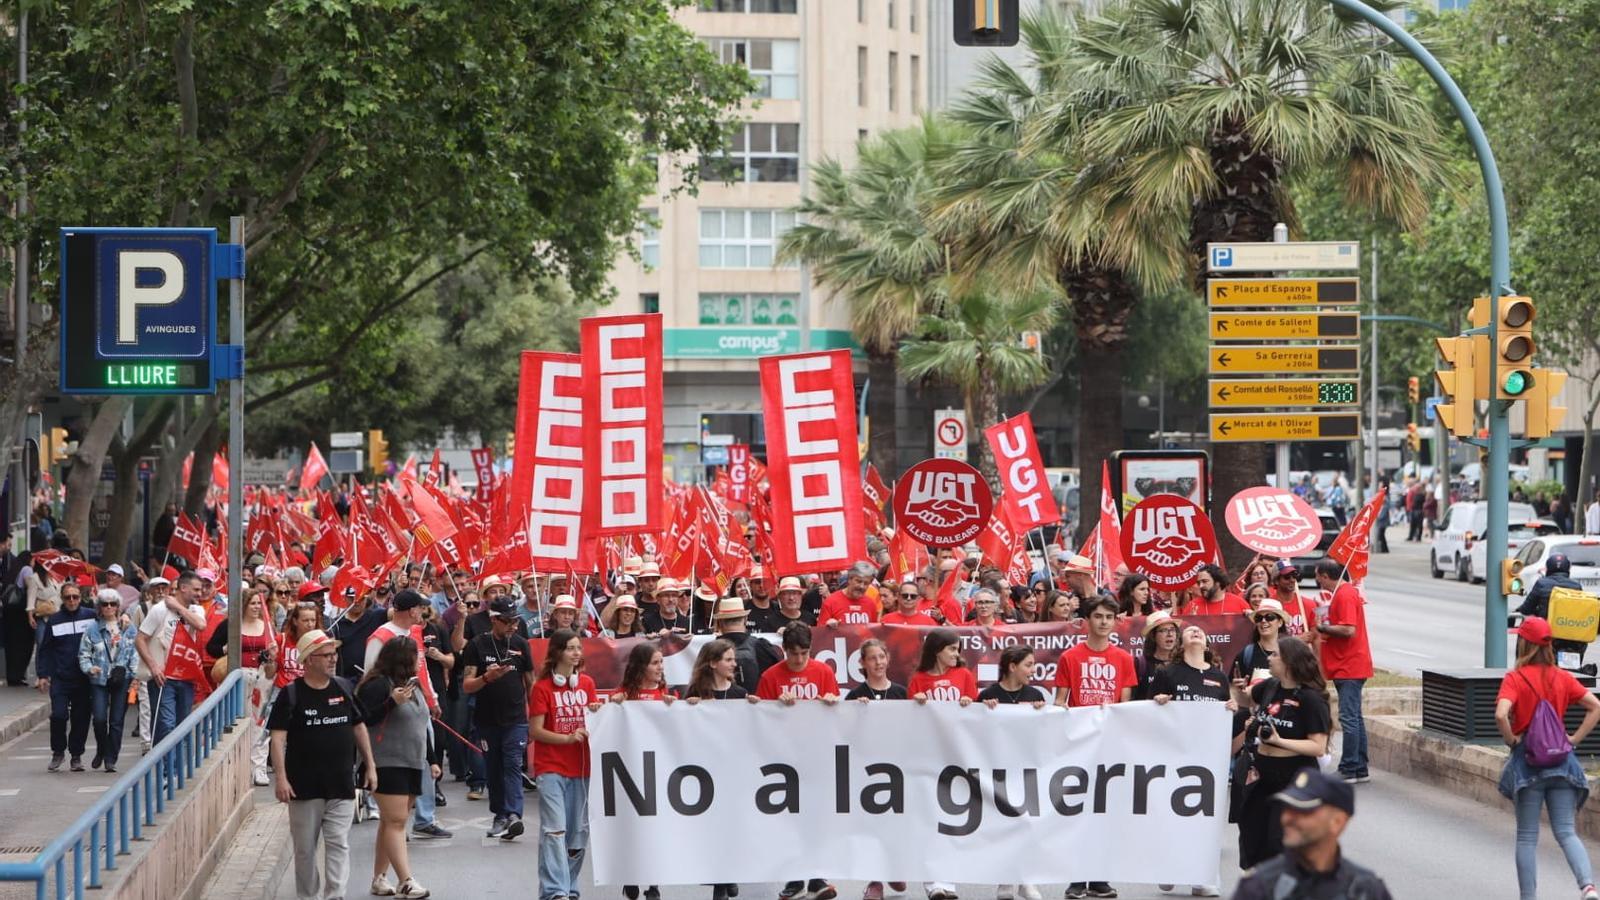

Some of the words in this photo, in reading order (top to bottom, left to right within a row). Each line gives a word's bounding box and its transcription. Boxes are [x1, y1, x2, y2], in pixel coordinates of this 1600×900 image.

[119, 252, 184, 342] P
[1233, 285, 1260, 294] Plaça
[1263, 285, 1312, 294] d'Espanya
[145, 325, 197, 334] AVINGUDES
[1234, 319, 1261, 327] Comte
[1265, 319, 1277, 327] de
[1280, 319, 1312, 327] Sallent
[719, 335, 780, 352] campus
[1255, 351, 1267, 360] Sa
[1271, 351, 1313, 360] Gerreria
[107, 365, 176, 384] LLIURE
[1233, 385, 1262, 393] Comtat
[1264, 385, 1277, 393] del
[1278, 384, 1313, 393] Rosselló
[599, 323, 647, 528] CCOO
[1233, 420, 1264, 428] Mercat
[1280, 419, 1312, 427] l'Olivar
[529, 360, 583, 560] CCOO
[779, 355, 848, 563] CCOO
[475, 452, 491, 499] UGT
[730, 448, 746, 500] UGT
[997, 425, 1042, 522] UGT
[909, 471, 976, 505] UGT
[1235, 494, 1300, 525] UGT
[1134, 506, 1197, 542] UGT
[907, 523, 932, 542] ILLES
[935, 524, 980, 544] BALEARS
[1136, 565, 1163, 584] ILLES
[1165, 561, 1206, 585] BALEARS
[844, 612, 870, 624] 100
[992, 636, 1018, 650] NO
[1022, 632, 1123, 650] TRINXES.
[1080, 662, 1116, 680] 100
[781, 682, 818, 699] 100
[1080, 678, 1117, 690] ANYS
[553, 689, 588, 707] 100
[556, 705, 585, 717] ANY
[322, 716, 348, 725] Guerra
[600, 750, 715, 816] No
[754, 762, 801, 815] a
[835, 745, 905, 815] la
[937, 761, 1215, 837] guerra
